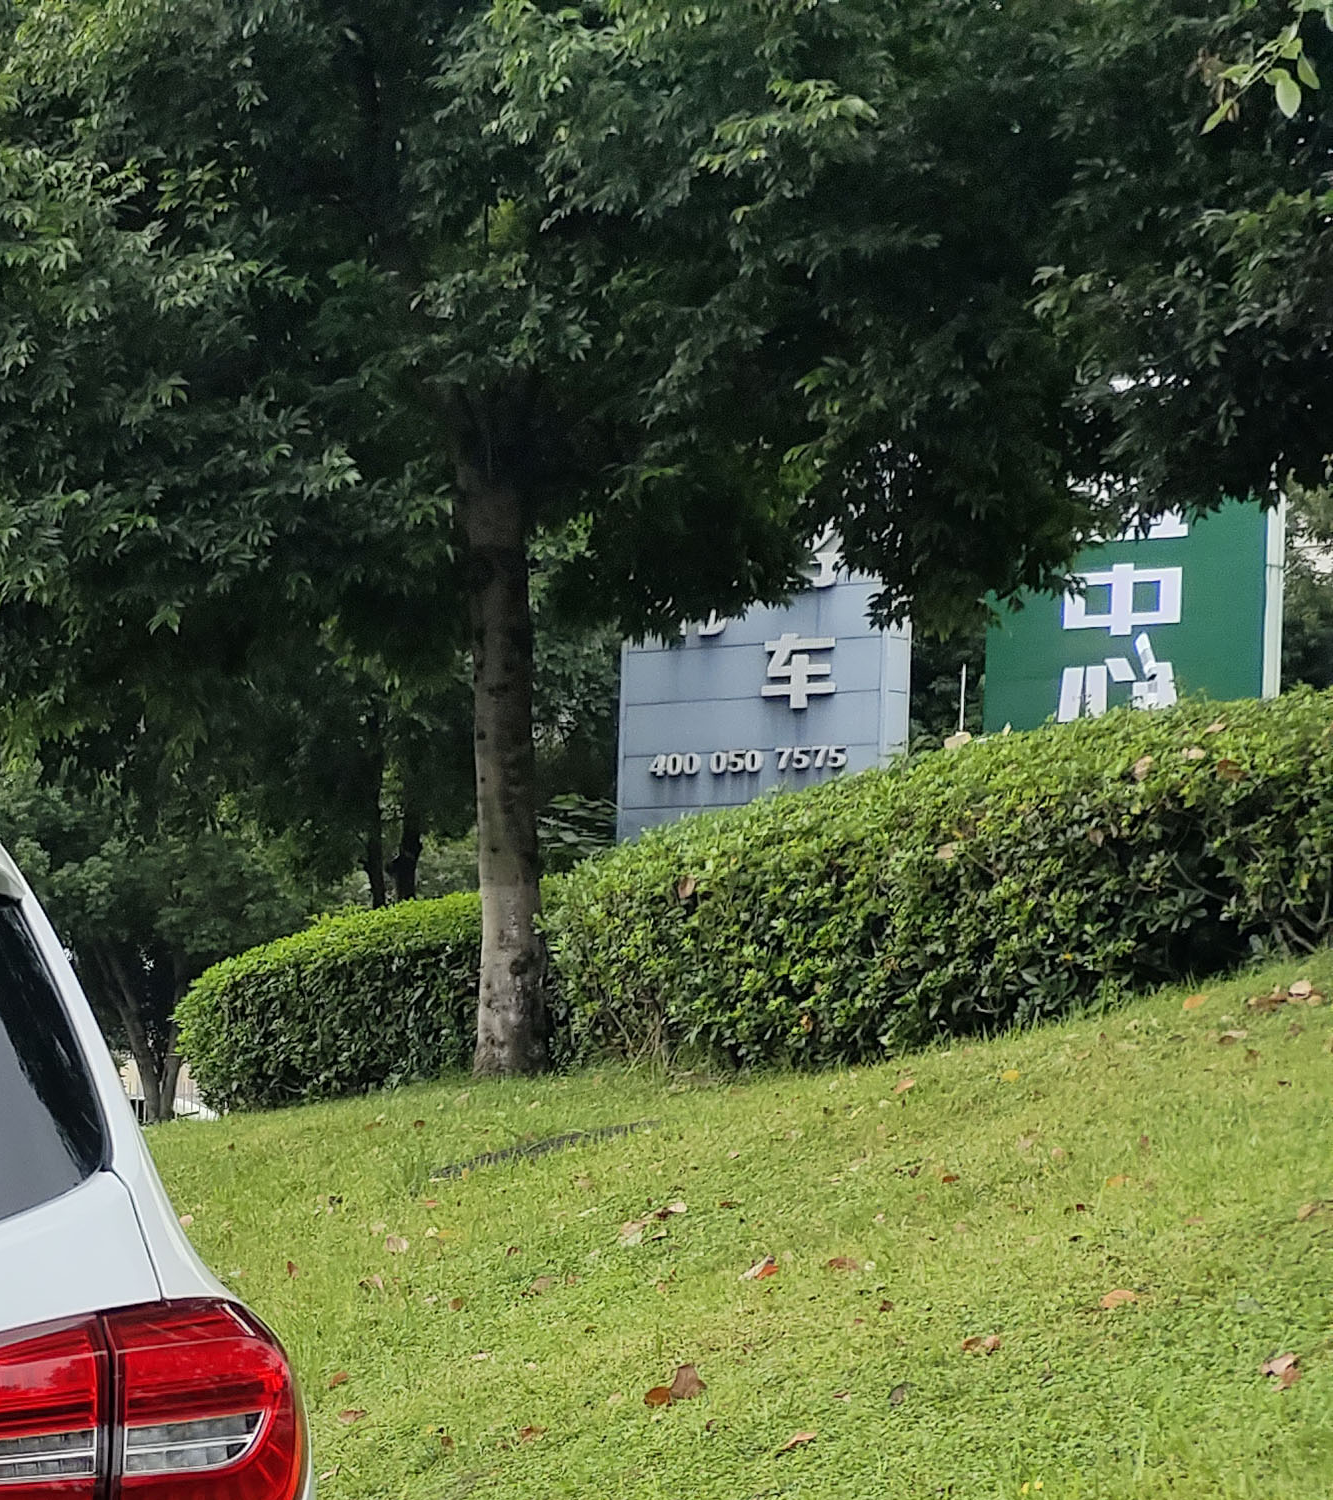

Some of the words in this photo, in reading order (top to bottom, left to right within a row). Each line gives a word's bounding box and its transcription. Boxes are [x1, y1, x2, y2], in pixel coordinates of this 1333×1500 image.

[761, 633, 836, 709] 车
[649, 753, 701, 777] 400
[709, 749, 763, 774] 050
[775, 745, 848, 770] 7575
